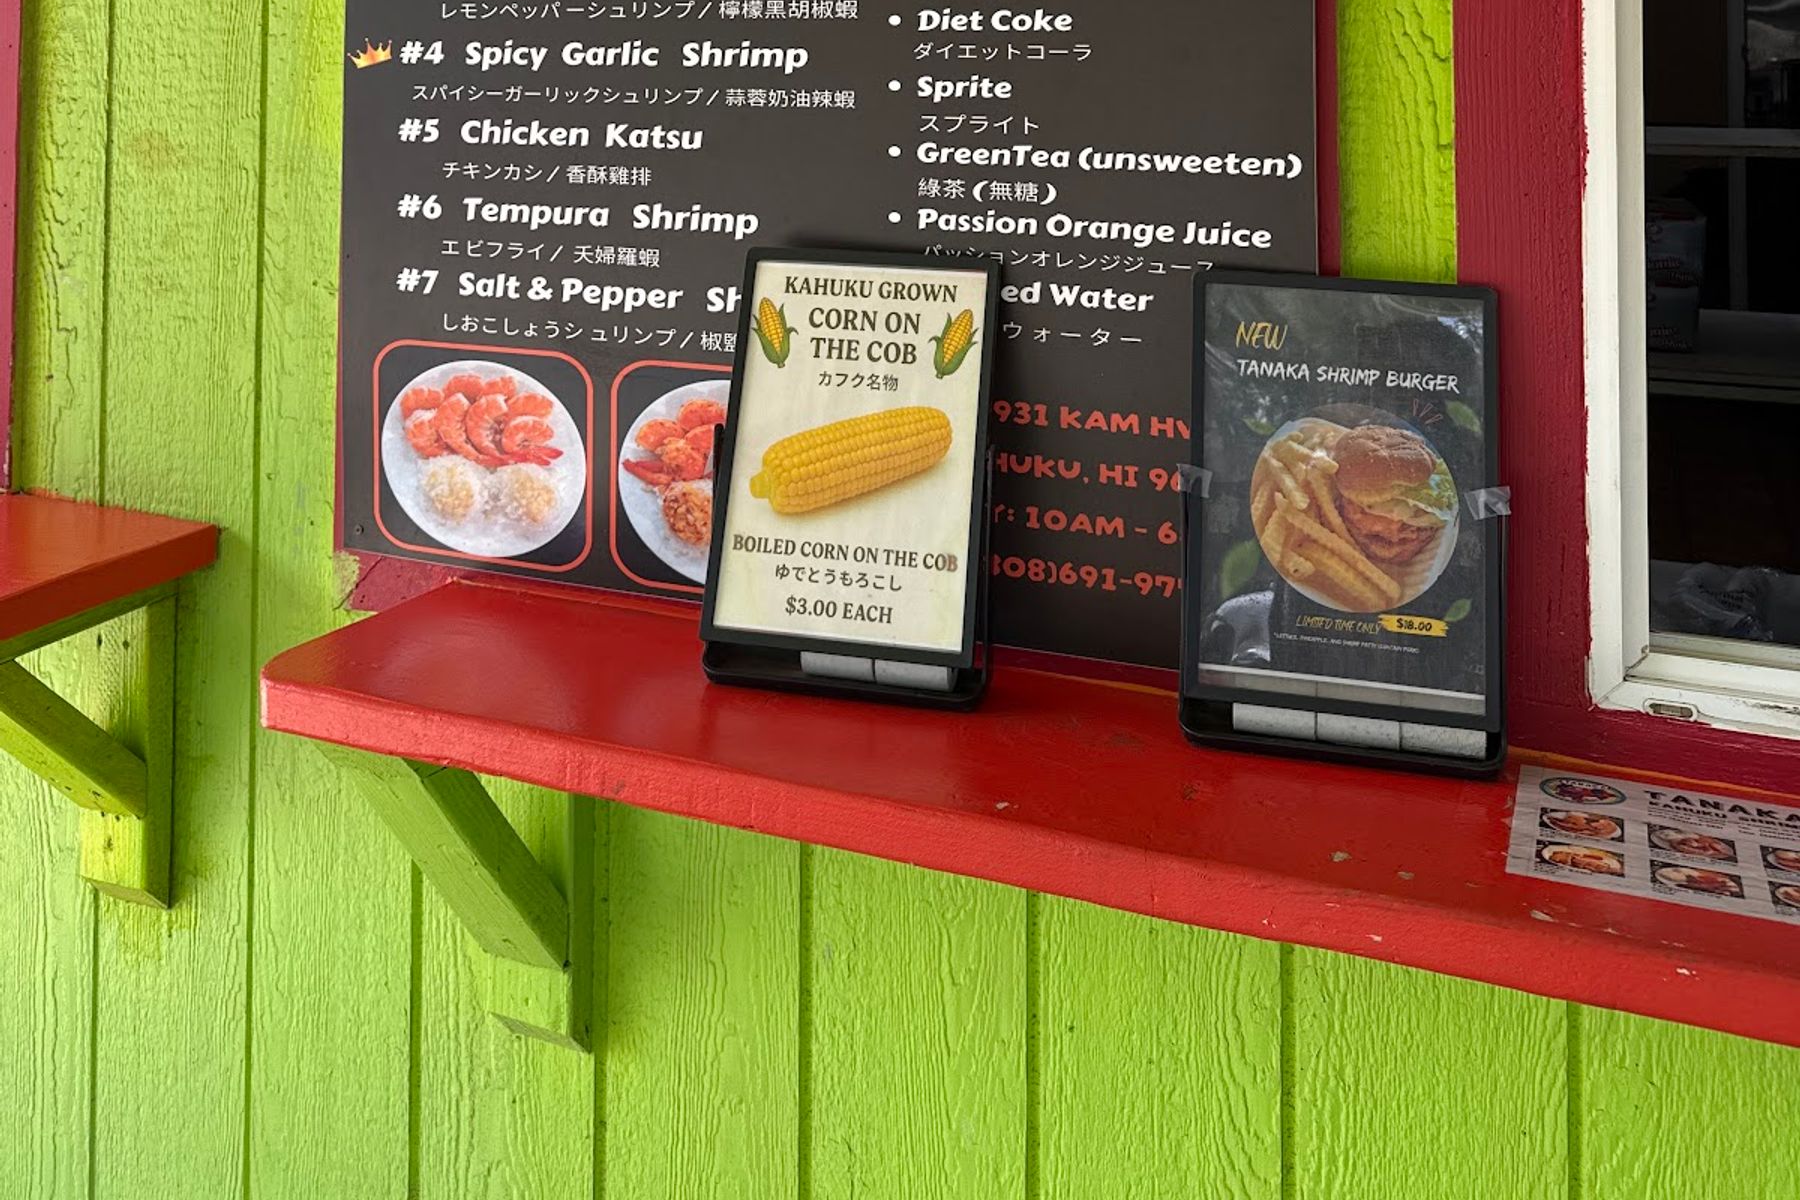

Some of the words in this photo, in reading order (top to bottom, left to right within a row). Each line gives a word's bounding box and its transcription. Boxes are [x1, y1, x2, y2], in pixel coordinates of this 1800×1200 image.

[917, 8, 984, 33] Diet
[991, 8, 1074, 32] Coke
[400, 39, 444, 65] #4
[465, 40, 548, 72] Spicy
[561, 39, 660, 67] Garlic
[682, 40, 810, 74] Shrimp
[913, 41, 1094, 62] ダイエットコーラ
[917, 74, 1013, 104] Sprite
[398, 117, 440, 143] #5
[460, 119, 590, 149] Chicken
[605, 123, 704, 150] Katsu
[918, 114, 1041, 136] スプライト
[1078, 146, 1303, 179] (unsweeten)
[397, 193, 443, 220] #6
[463, 196, 609, 231] Tempura
[633, 202, 760, 240] Shrimp
[917, 208, 1038, 236] Passion
[1045, 213, 1175, 248] Orange
[1183, 221, 1273, 249] Juice
[397, 268, 438, 294] #7
[458, 271, 519, 300] Salt
[526, 275, 554, 301] &
[560, 280, 684, 312] Pepper
[706, 286, 742, 314] Sh
[785, 277, 874, 298] KAHUKU
[878, 282, 958, 303] GROWN
[1049, 283, 1155, 312] Water
[808, 307, 877, 332] CORN
[885, 311, 921, 335] ON
[1235, 320, 1289, 351] NEW
[810, 337, 860, 361] THE
[867, 341, 917, 365] COB
[818, 371, 899, 392] カフク名物
[1237, 359, 1309, 382] TANAKA
[1317, 365, 1380, 386] SHRIMP
[1386, 370, 1460, 394] BURGER
[1059, 405, 1140, 435] KAM
[1099, 463, 1139, 488] HI
[1026, 506, 1125, 538] 10AM
[732, 534, 796, 556] BOILED
[801, 541, 848, 561] CORN
[853, 546, 878, 564] ON
[883, 549, 917, 569] THE
[922, 553, 958, 572] COB
[775, 564, 902, 591] ゆでとうもろこし
[785, 596, 837, 618] $3.00
[842, 603, 893, 624] EACH
[1396, 618, 1433, 632] $18.00
